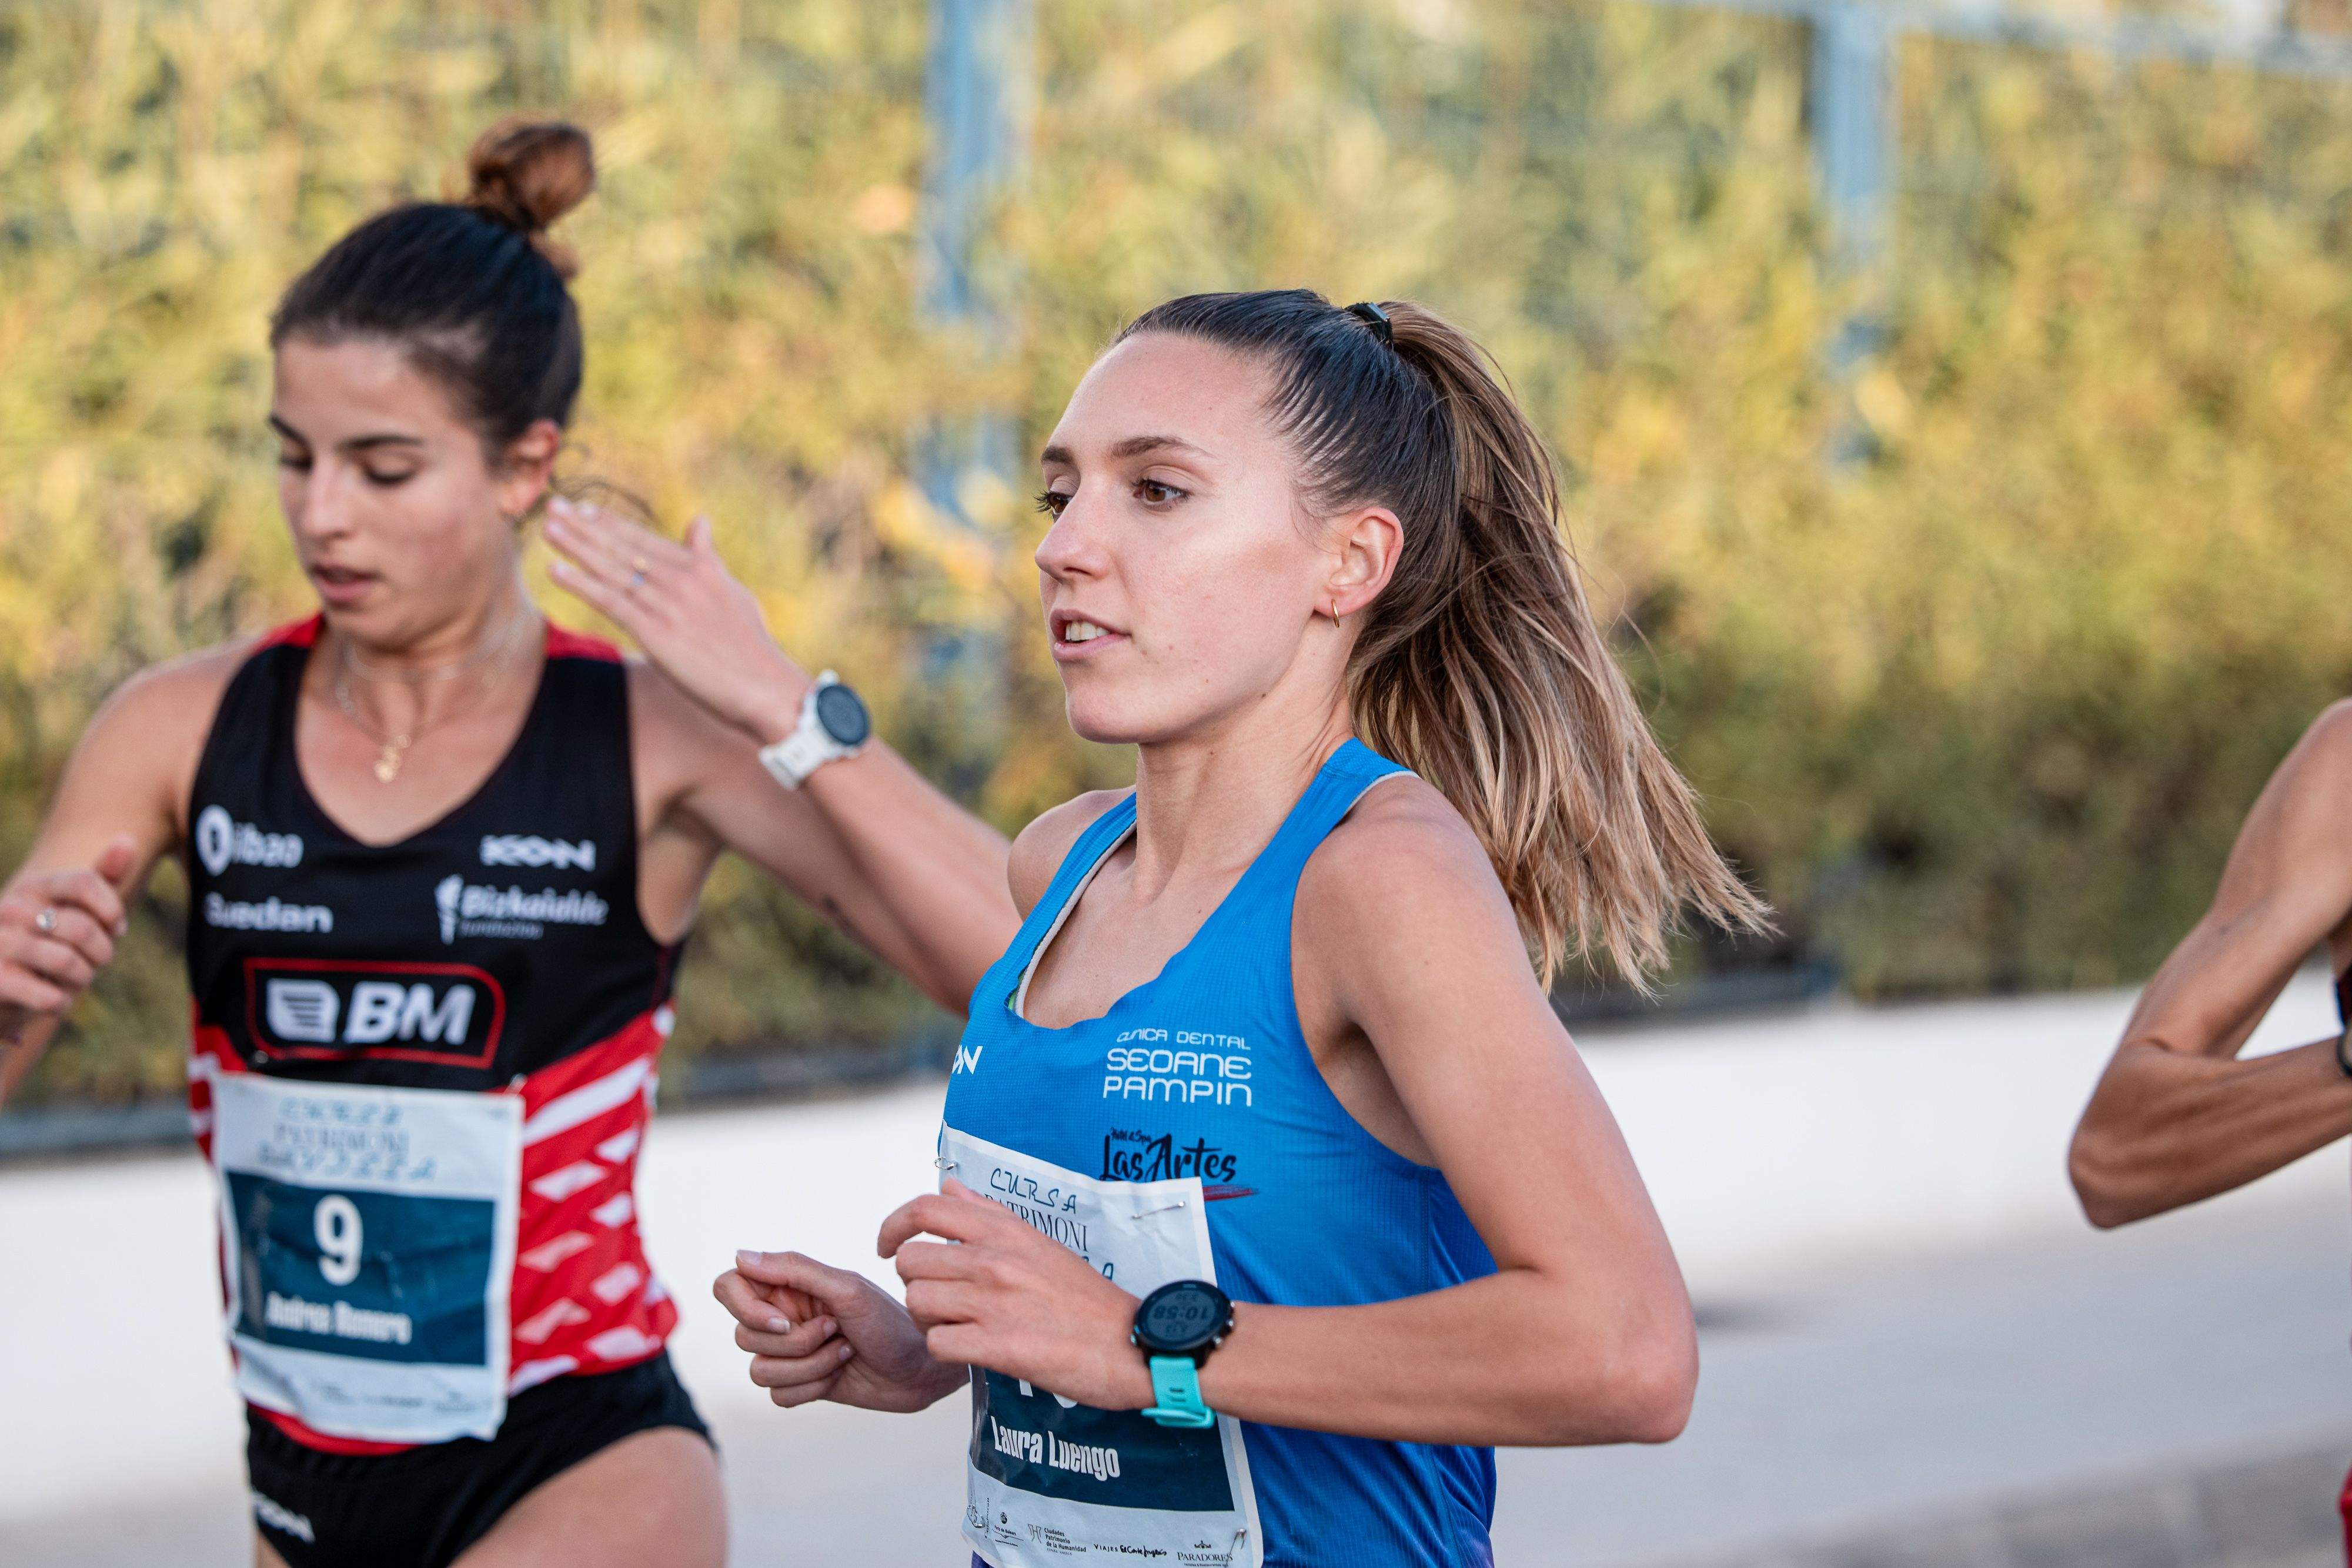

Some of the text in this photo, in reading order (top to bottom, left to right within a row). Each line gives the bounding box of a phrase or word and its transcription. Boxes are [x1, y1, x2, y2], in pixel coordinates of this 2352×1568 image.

[343, 981, 476, 1045] BM
[1176, 1031, 1251, 1051] DENTAL
[1107, 1048, 1252, 1080] SEOANE
[1102, 1076, 1252, 1107] PAMPIN
[990, 1168, 1077, 1214] CURSA
[314, 1194, 363, 1286] 9
[991, 1415, 1121, 1482] Laura Luengo
[1044, 1527, 1065, 1537] Ciudades
[1045, 1534, 1071, 1544] Patrimonio
[1058, 1543, 1087, 1552] Humanidad
[1094, 1543, 1118, 1553] VIAJES
[1177, 1552, 1233, 1562] PARADORES
